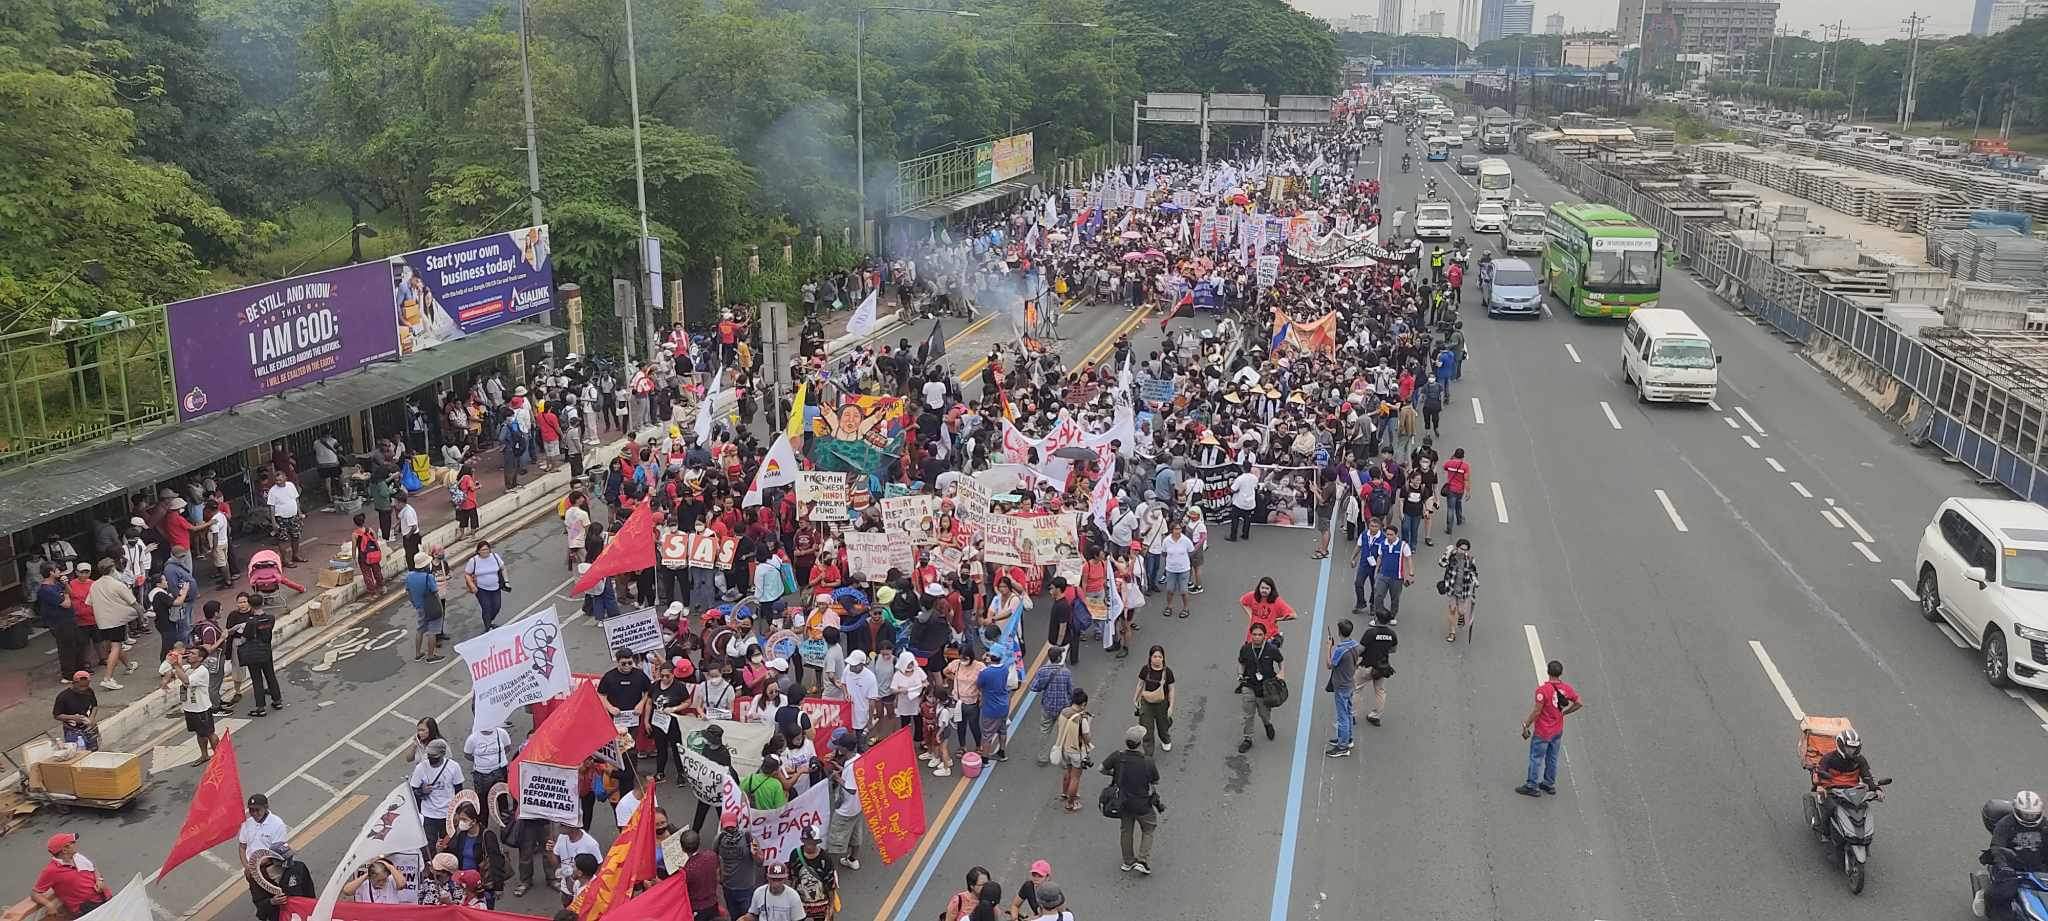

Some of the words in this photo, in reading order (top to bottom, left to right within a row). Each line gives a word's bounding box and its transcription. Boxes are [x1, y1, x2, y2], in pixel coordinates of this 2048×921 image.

[426, 255, 453, 272] Start
[454, 249, 477, 268] your
[479, 244, 500, 257] own
[441, 267, 485, 287] business
[486, 255, 516, 275] today!
[245, 303, 260, 323] BE
[260, 291, 286, 315] STILL,
[286, 286, 305, 305] AND
[305, 283, 330, 300] KNOW
[511, 286, 549, 308] ASIALINK
[281, 304, 302, 318] THAT
[248, 332, 257, 365] I
[262, 321, 293, 361] AM
[296, 308, 339, 349] GOD;
[256, 364, 269, 377] WILL
[276, 355, 296, 372] EXALTED
[287, 365, 306, 380] EXALTED
[1033, 516, 1060, 530] JUNK
[613, 618, 652, 634] PALAKASIN
[624, 627, 648, 637] LOKAL
[528, 782, 569, 795] AGRARIAN
[532, 776, 567, 786] GENUINE
[523, 789, 555, 800] REFORM
[556, 794, 573, 804] BILL
[856, 767, 874, 814] CAGAYAN
